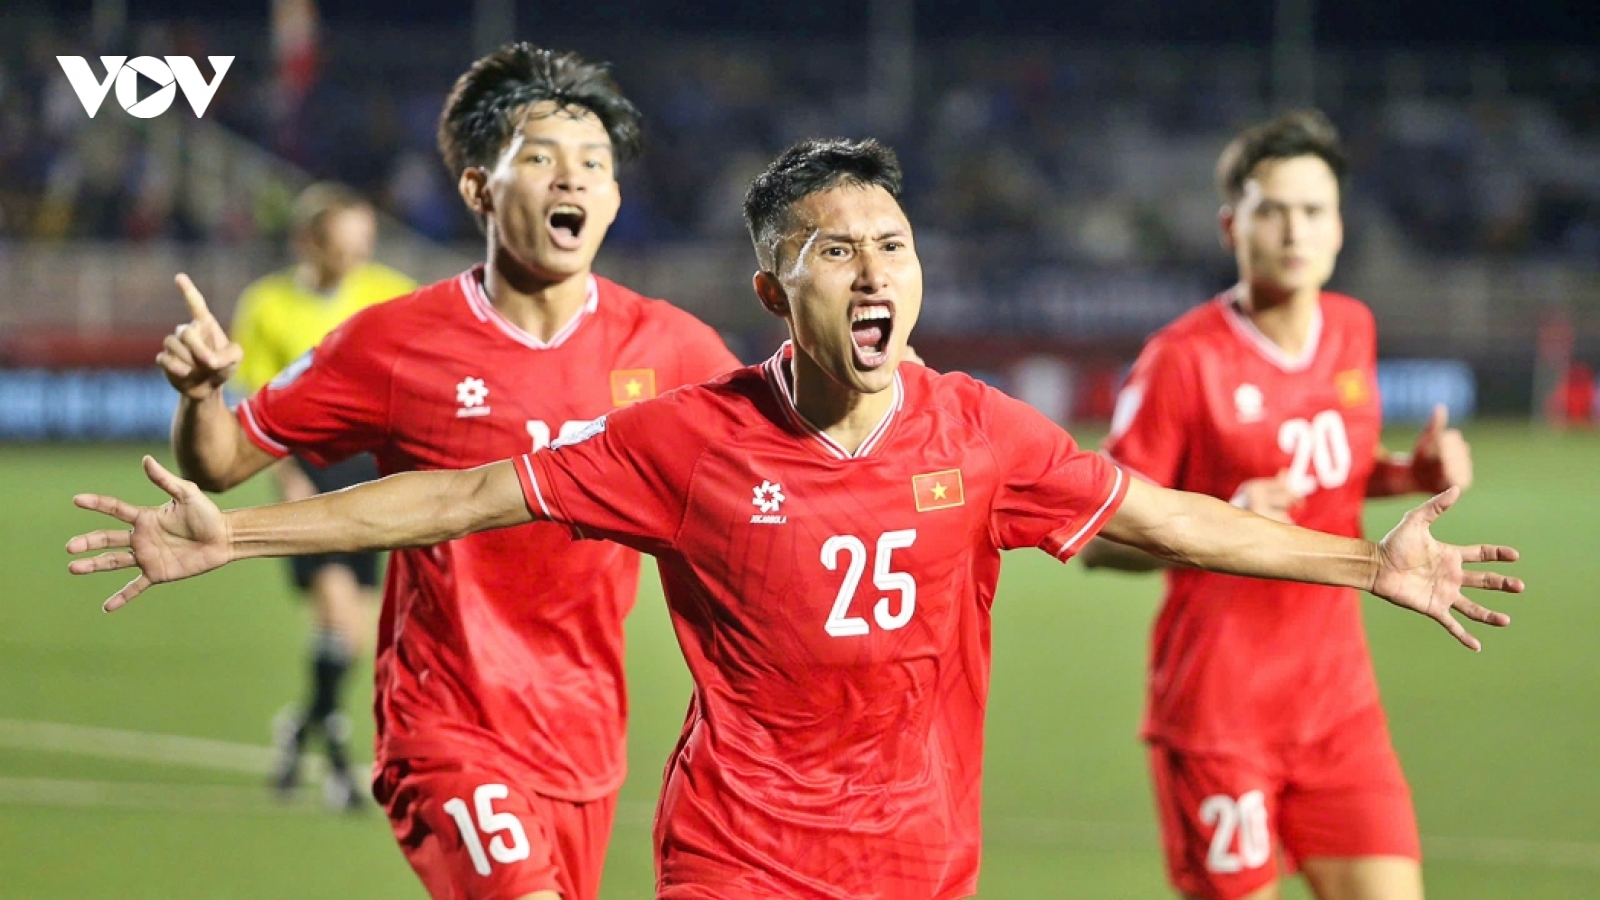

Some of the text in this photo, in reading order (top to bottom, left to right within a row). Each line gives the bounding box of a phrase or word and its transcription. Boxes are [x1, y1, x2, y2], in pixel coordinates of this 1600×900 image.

[1278, 409, 1351, 498] 20
[820, 528, 917, 637] 25
[443, 783, 530, 876] 15
[1199, 790, 1269, 873] 20
